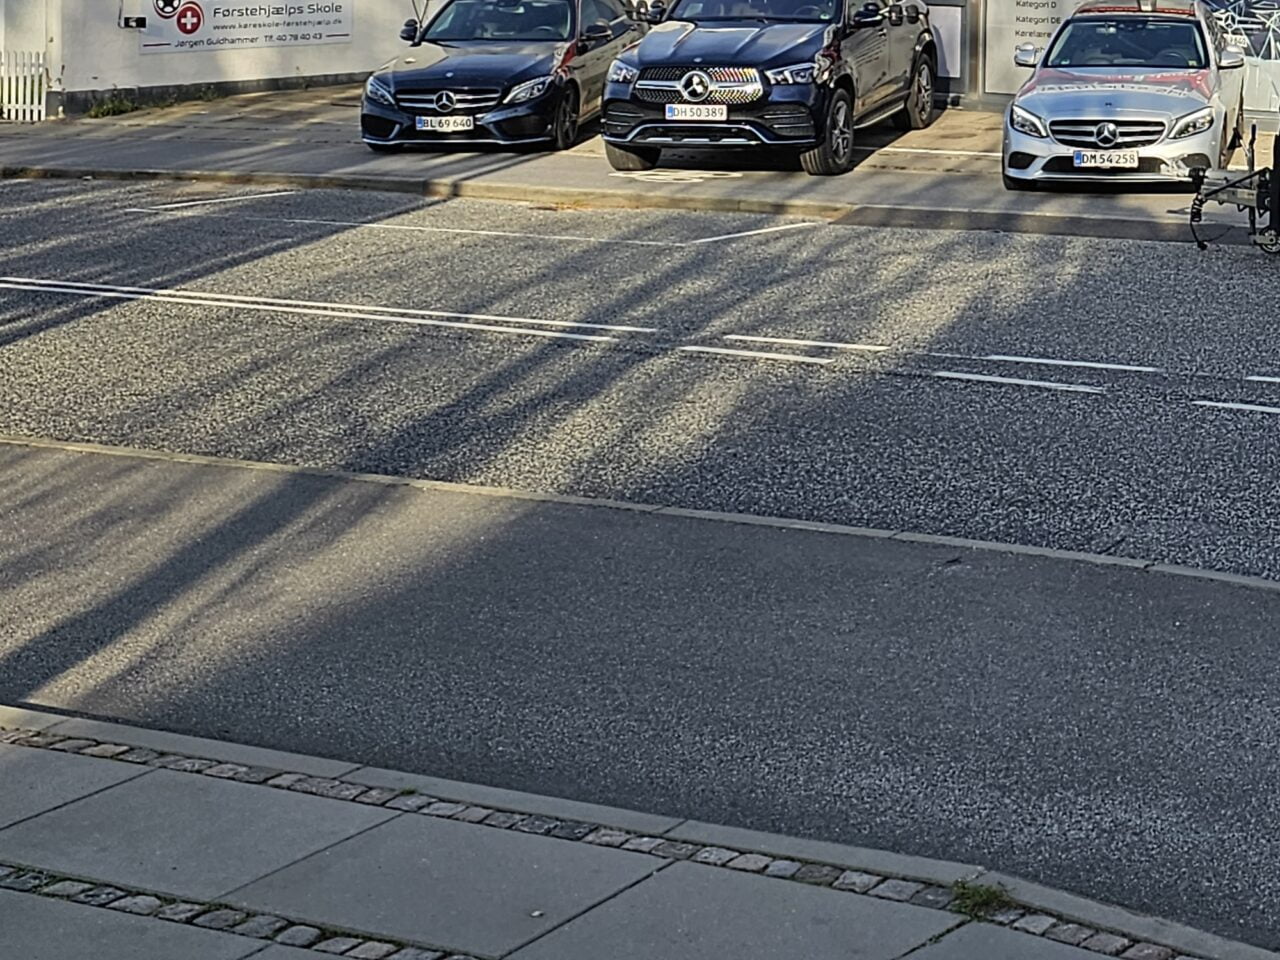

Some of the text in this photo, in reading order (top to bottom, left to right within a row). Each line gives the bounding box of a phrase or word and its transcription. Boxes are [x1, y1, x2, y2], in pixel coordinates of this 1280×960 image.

[1016, 0, 1049, 9] Kategori
[213, 3, 343, 18] Førstehjælps Skole
[213, 18, 343, 31] www.køreskole-førstehjælp.dk
[1015, 16, 1049, 25] Kategori
[299, 33, 310, 41] 40
[174, 39, 205, 49] Jørgen
[673, 107, 724, 117] DH 50 389
[423, 119, 472, 128] BL 69 640
[1082, 154, 1136, 164] DM 54 258
